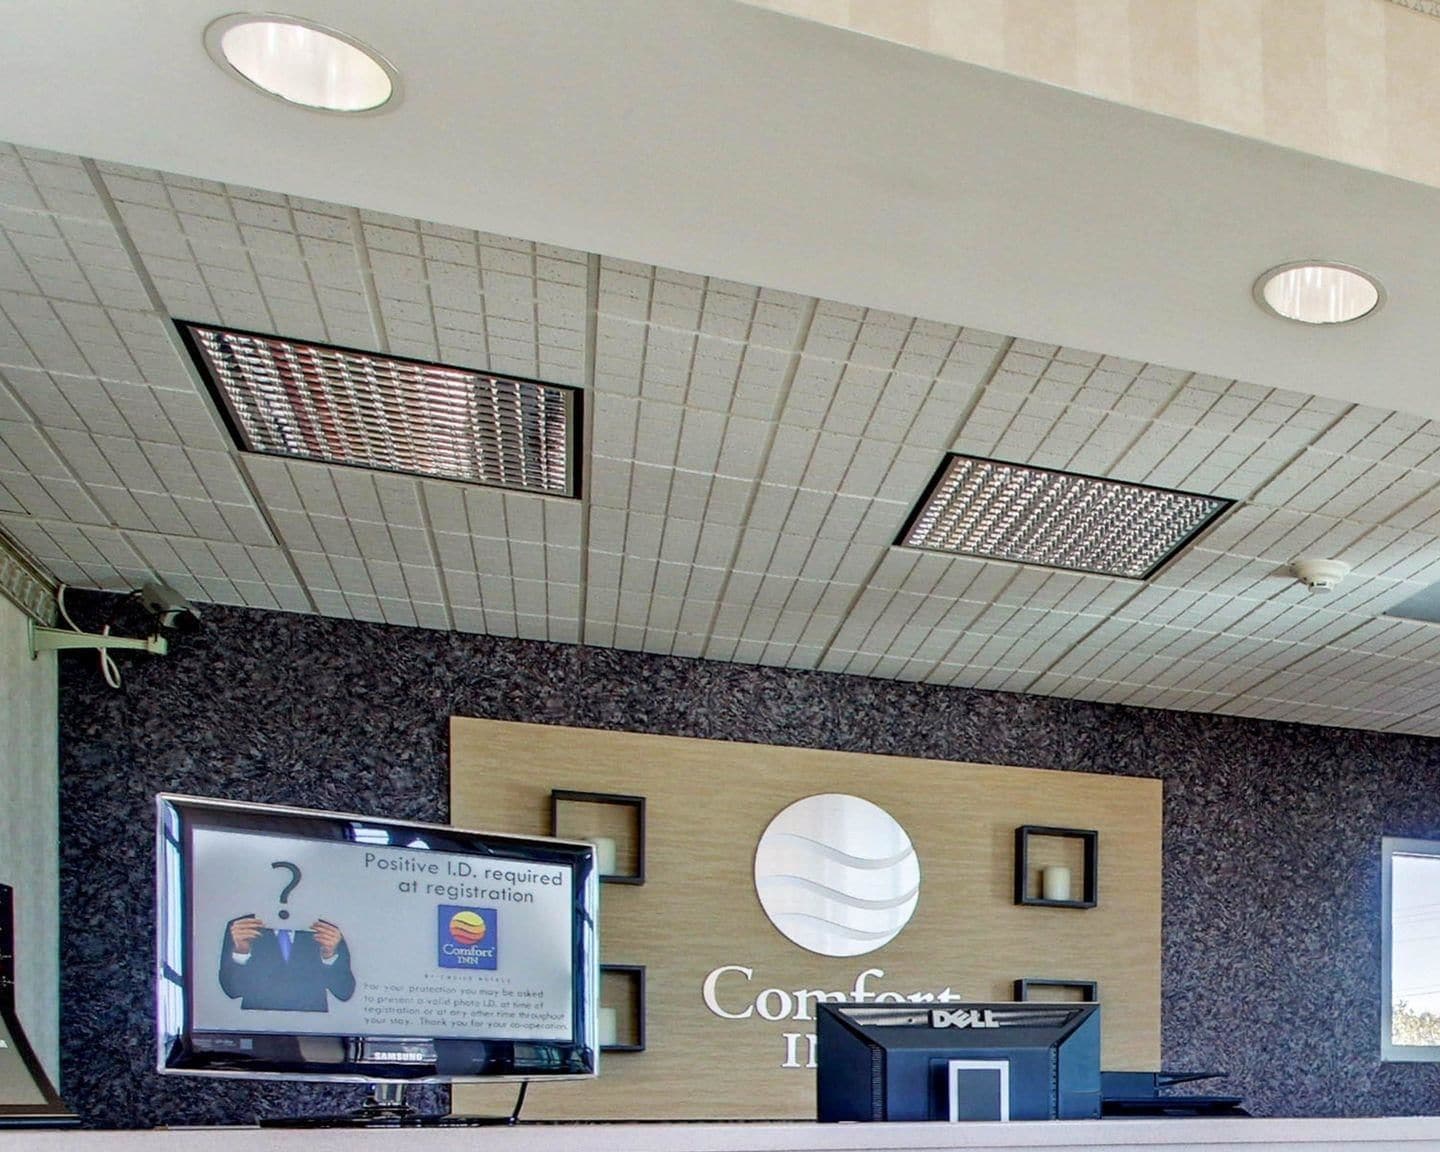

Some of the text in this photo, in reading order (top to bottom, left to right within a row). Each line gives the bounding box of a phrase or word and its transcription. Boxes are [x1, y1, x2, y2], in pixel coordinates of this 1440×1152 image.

[365, 852, 563, 886] Positive I.D. required
[399, 881, 534, 903] at registration
[443, 943, 495, 957] Comfort
[409, 986, 457, 994] protection
[517, 989, 544, 998] asked
[932, 1009, 1000, 1028] DELL
[374, 1051, 423, 1061] SAMSUNG
